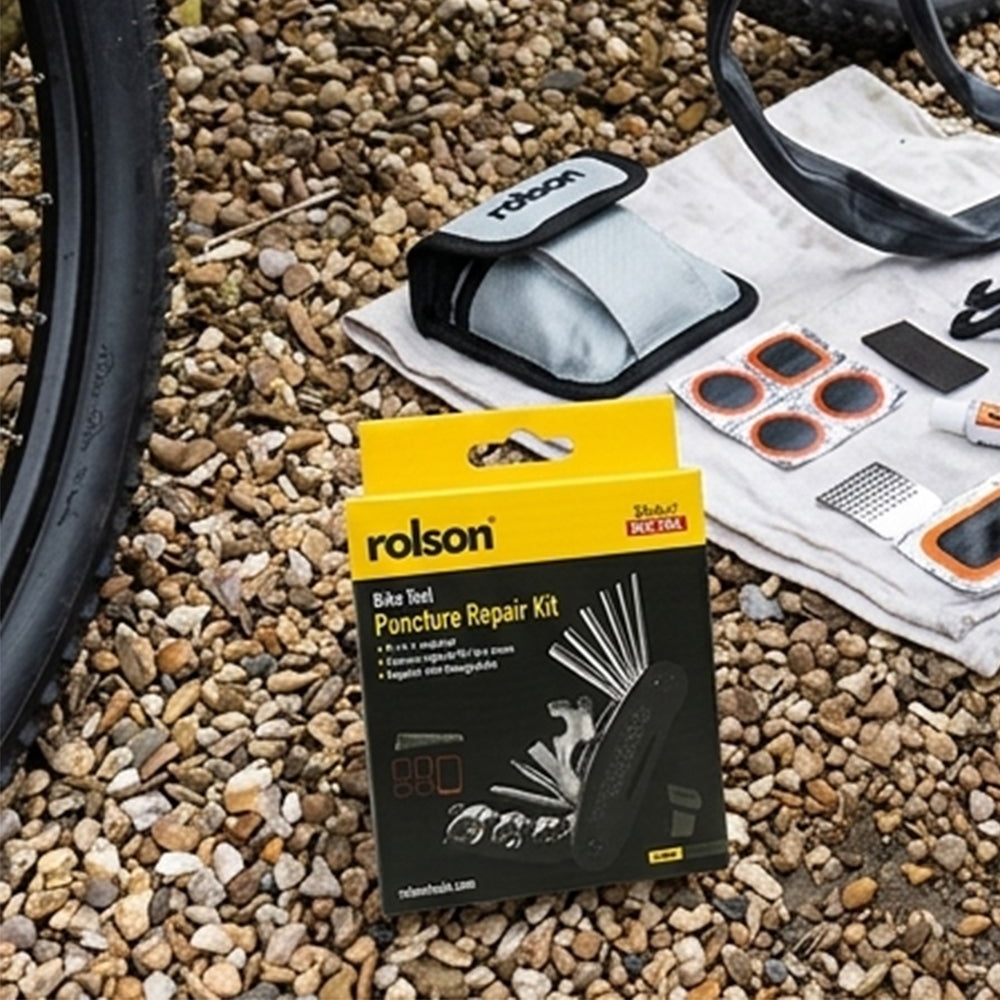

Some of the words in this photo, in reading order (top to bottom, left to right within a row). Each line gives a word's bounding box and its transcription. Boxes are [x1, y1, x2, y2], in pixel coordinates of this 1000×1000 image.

[367, 518, 495, 562] rolson
[466, 598, 528, 630] Repair
[532, 593, 560, 619] Kit
